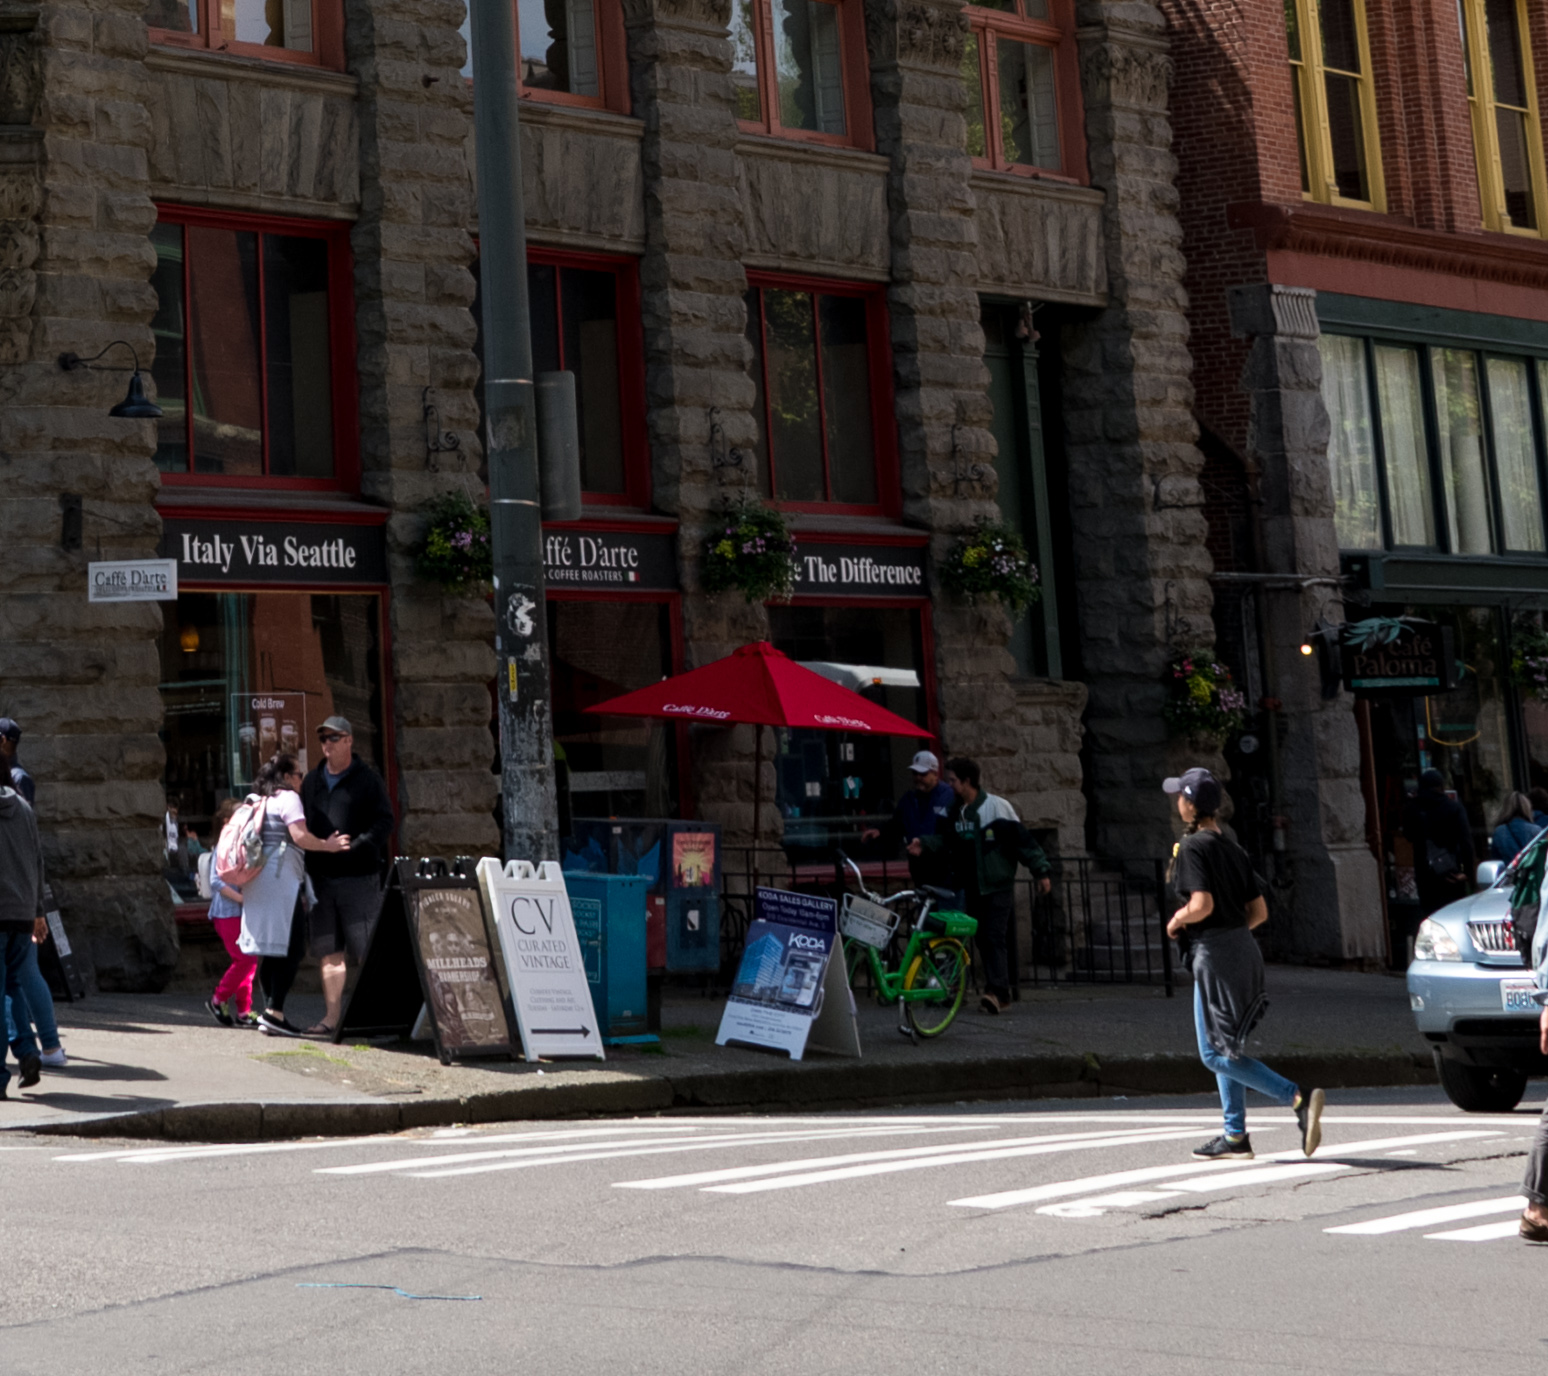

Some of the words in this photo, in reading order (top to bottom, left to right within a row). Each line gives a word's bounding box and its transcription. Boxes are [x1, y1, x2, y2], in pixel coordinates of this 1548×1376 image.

[180, 533, 235, 573] Italy
[239, 534, 278, 566] Via
[283, 536, 356, 568] Seattle
[543, 535, 572, 566] ffé
[578, 537, 639, 568] D'arte
[548, 568, 580, 581] COFFEE
[582, 569, 623, 582] ROASTERS
[803, 556, 837, 583] The
[839, 556, 922, 585] Difference
[1353, 652, 1437, 676] Paloma
[251, 698, 267, 709] Cold
[267, 698, 285, 709] Brew
[758, 891, 778, 901] KODA
[779, 894, 801, 905] SALES
[801, 898, 834, 912] GALLERY
[511, 896, 555, 935] CV
[517, 939, 567, 953] CURATED
[787, 932, 826, 952] KODA
[426, 957, 488, 970] MILLHEADS
[521, 955, 570, 970] VINTAGE
